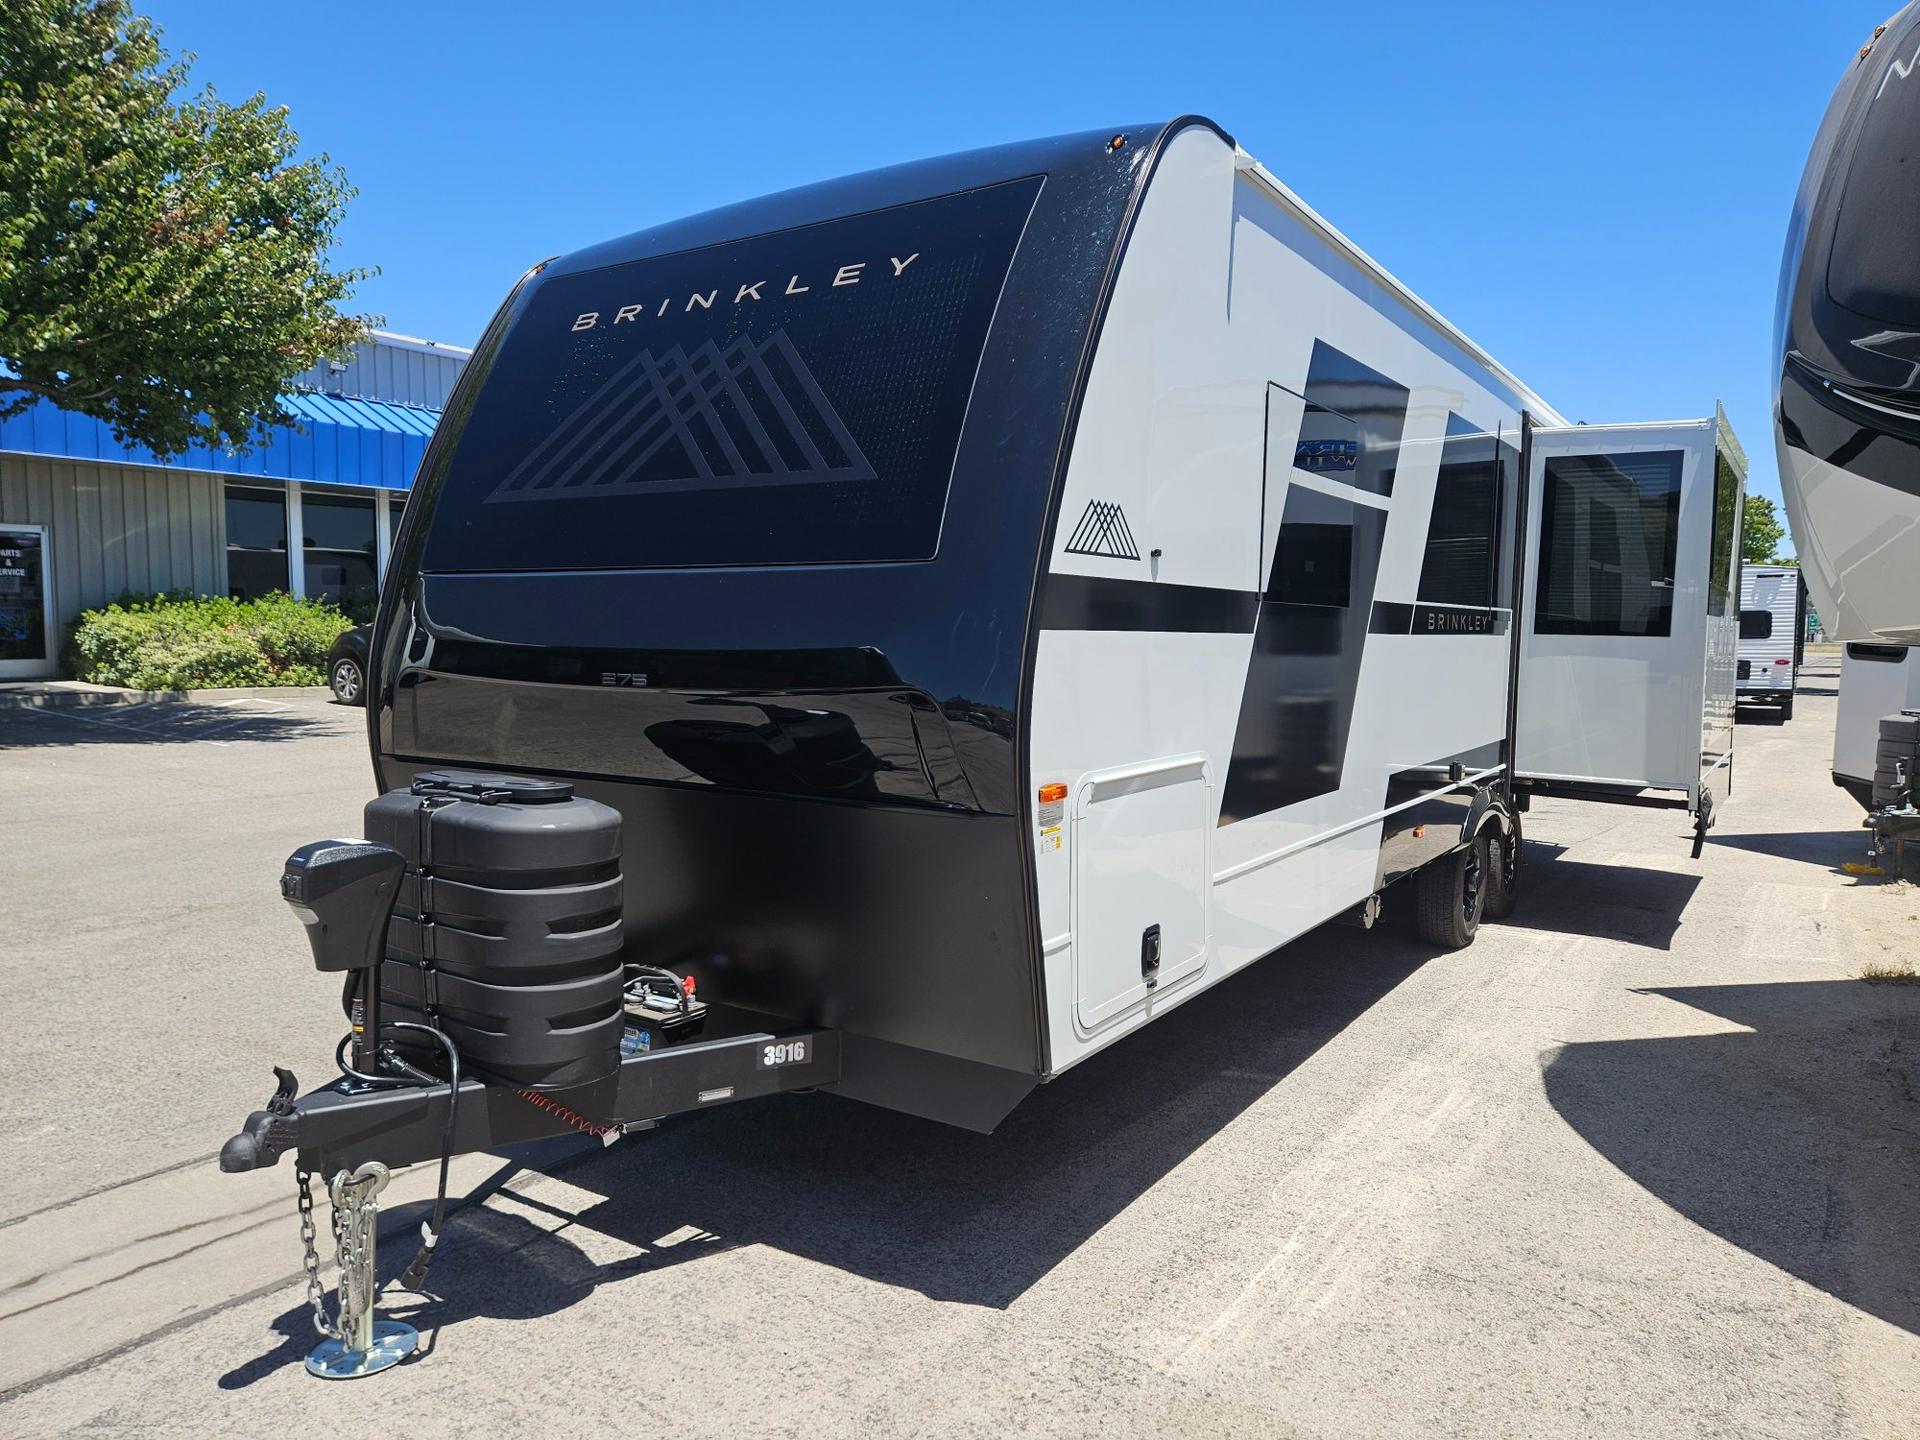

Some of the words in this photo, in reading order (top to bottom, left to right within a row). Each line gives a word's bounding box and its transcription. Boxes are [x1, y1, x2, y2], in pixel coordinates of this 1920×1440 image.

[571, 253, 919, 331] BRINKLEY
[0, 549, 23, 558] ARTS
[1428, 613, 1487, 630] BRINKLEY
[763, 1041, 805, 1066] 3916
